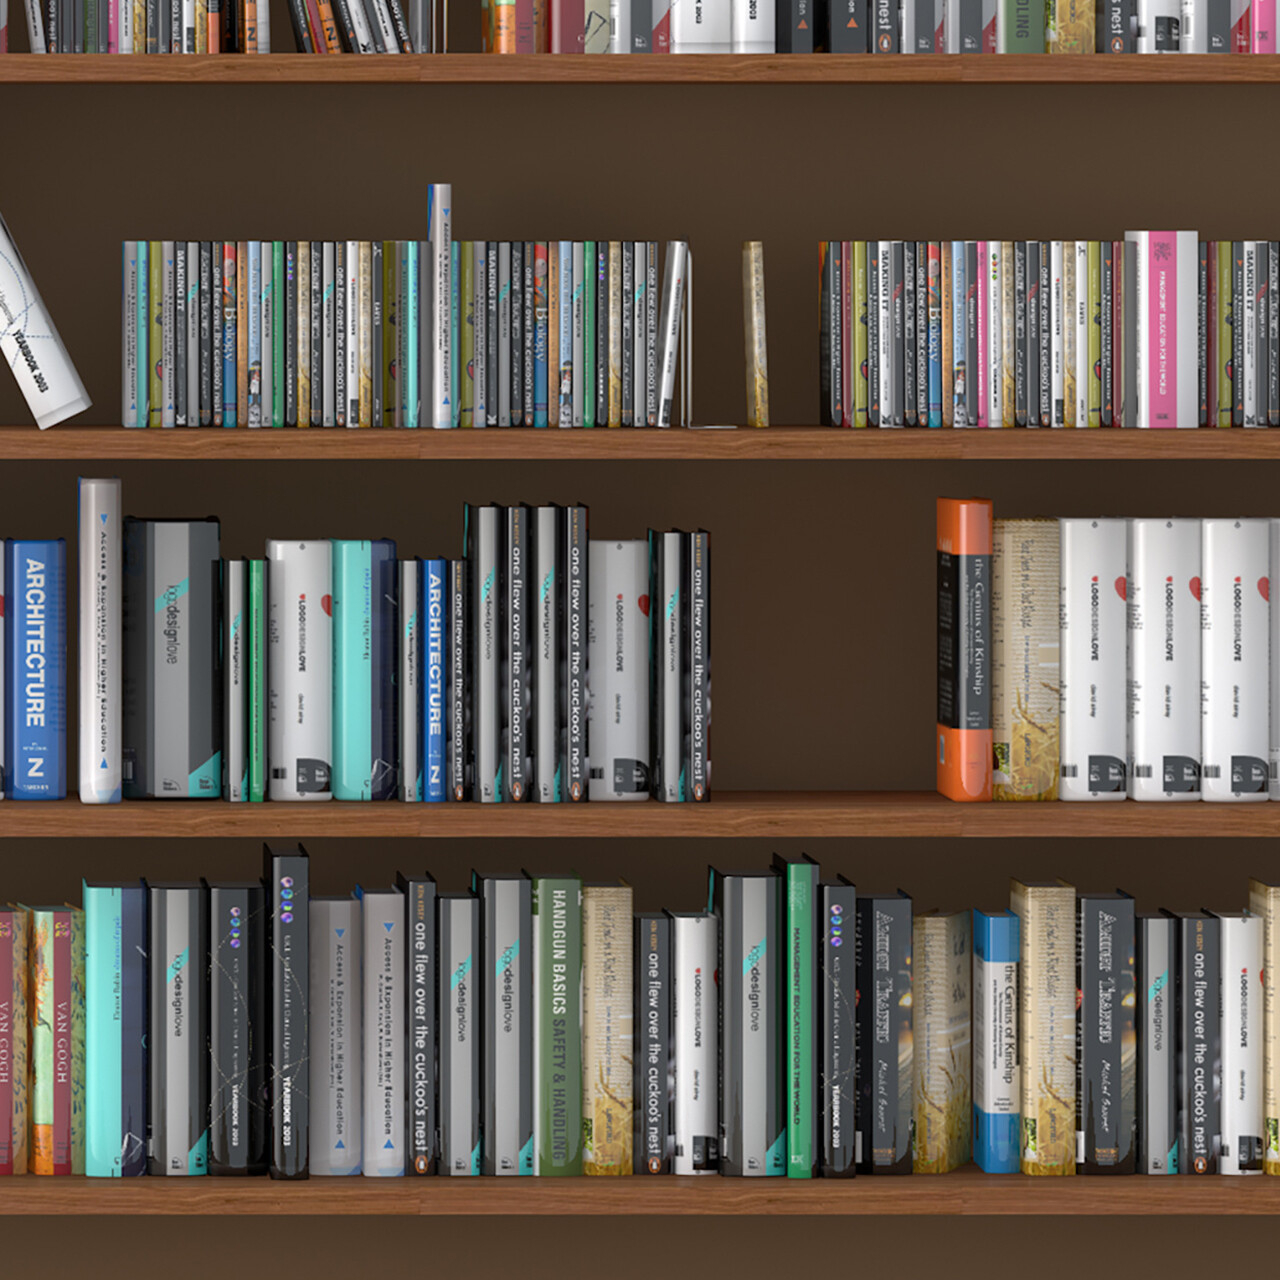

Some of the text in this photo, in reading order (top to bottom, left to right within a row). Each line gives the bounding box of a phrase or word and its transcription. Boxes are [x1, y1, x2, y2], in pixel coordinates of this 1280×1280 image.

[879, 1, 892, 30] nest
[1111, 7, 1124, 34] nest
[177, 250, 185, 311] MAKING IT
[882, 300, 889, 311] IT
[12, 329, 49, 393] YEARBOOK 2003
[223, 307, 236, 362] Biology
[534, 307, 548, 362] Biology
[927, 307, 940, 362] Biology
[26, 558, 45, 727] ARCHITECTURE
[430, 574, 441, 735] ARCHITECTURE
[973, 559, 984, 695] the Genius of Kinship
[27, 757, 44, 777] N
[431, 765, 440, 784] N
[385, 938, 393, 972] Access
[384, 986, 393, 1035] Expansion
[414, 923, 429, 1151] one flew over the cuckoo's nest
[552, 890, 566, 1159] HANDGUN BASICS SAFETY & HANDLING
[793, 927, 801, 1125] MANAGEMENT EDUCATION FOR THE WORLD
[1002, 965, 1015, 1083] the Genius of Kinship
[57, 1002, 68, 1083] VAN GOGH
[384, 1051, 393, 1083] Higher
[385, 1039, 393, 1047] in
[1194, 953, 1207, 1154] one flew over the cuckoo's nest
[282, 1076, 291, 1123] YEARBOOK
[385, 1086, 393, 1135] Education
[282, 1126, 291, 1146] 2003
